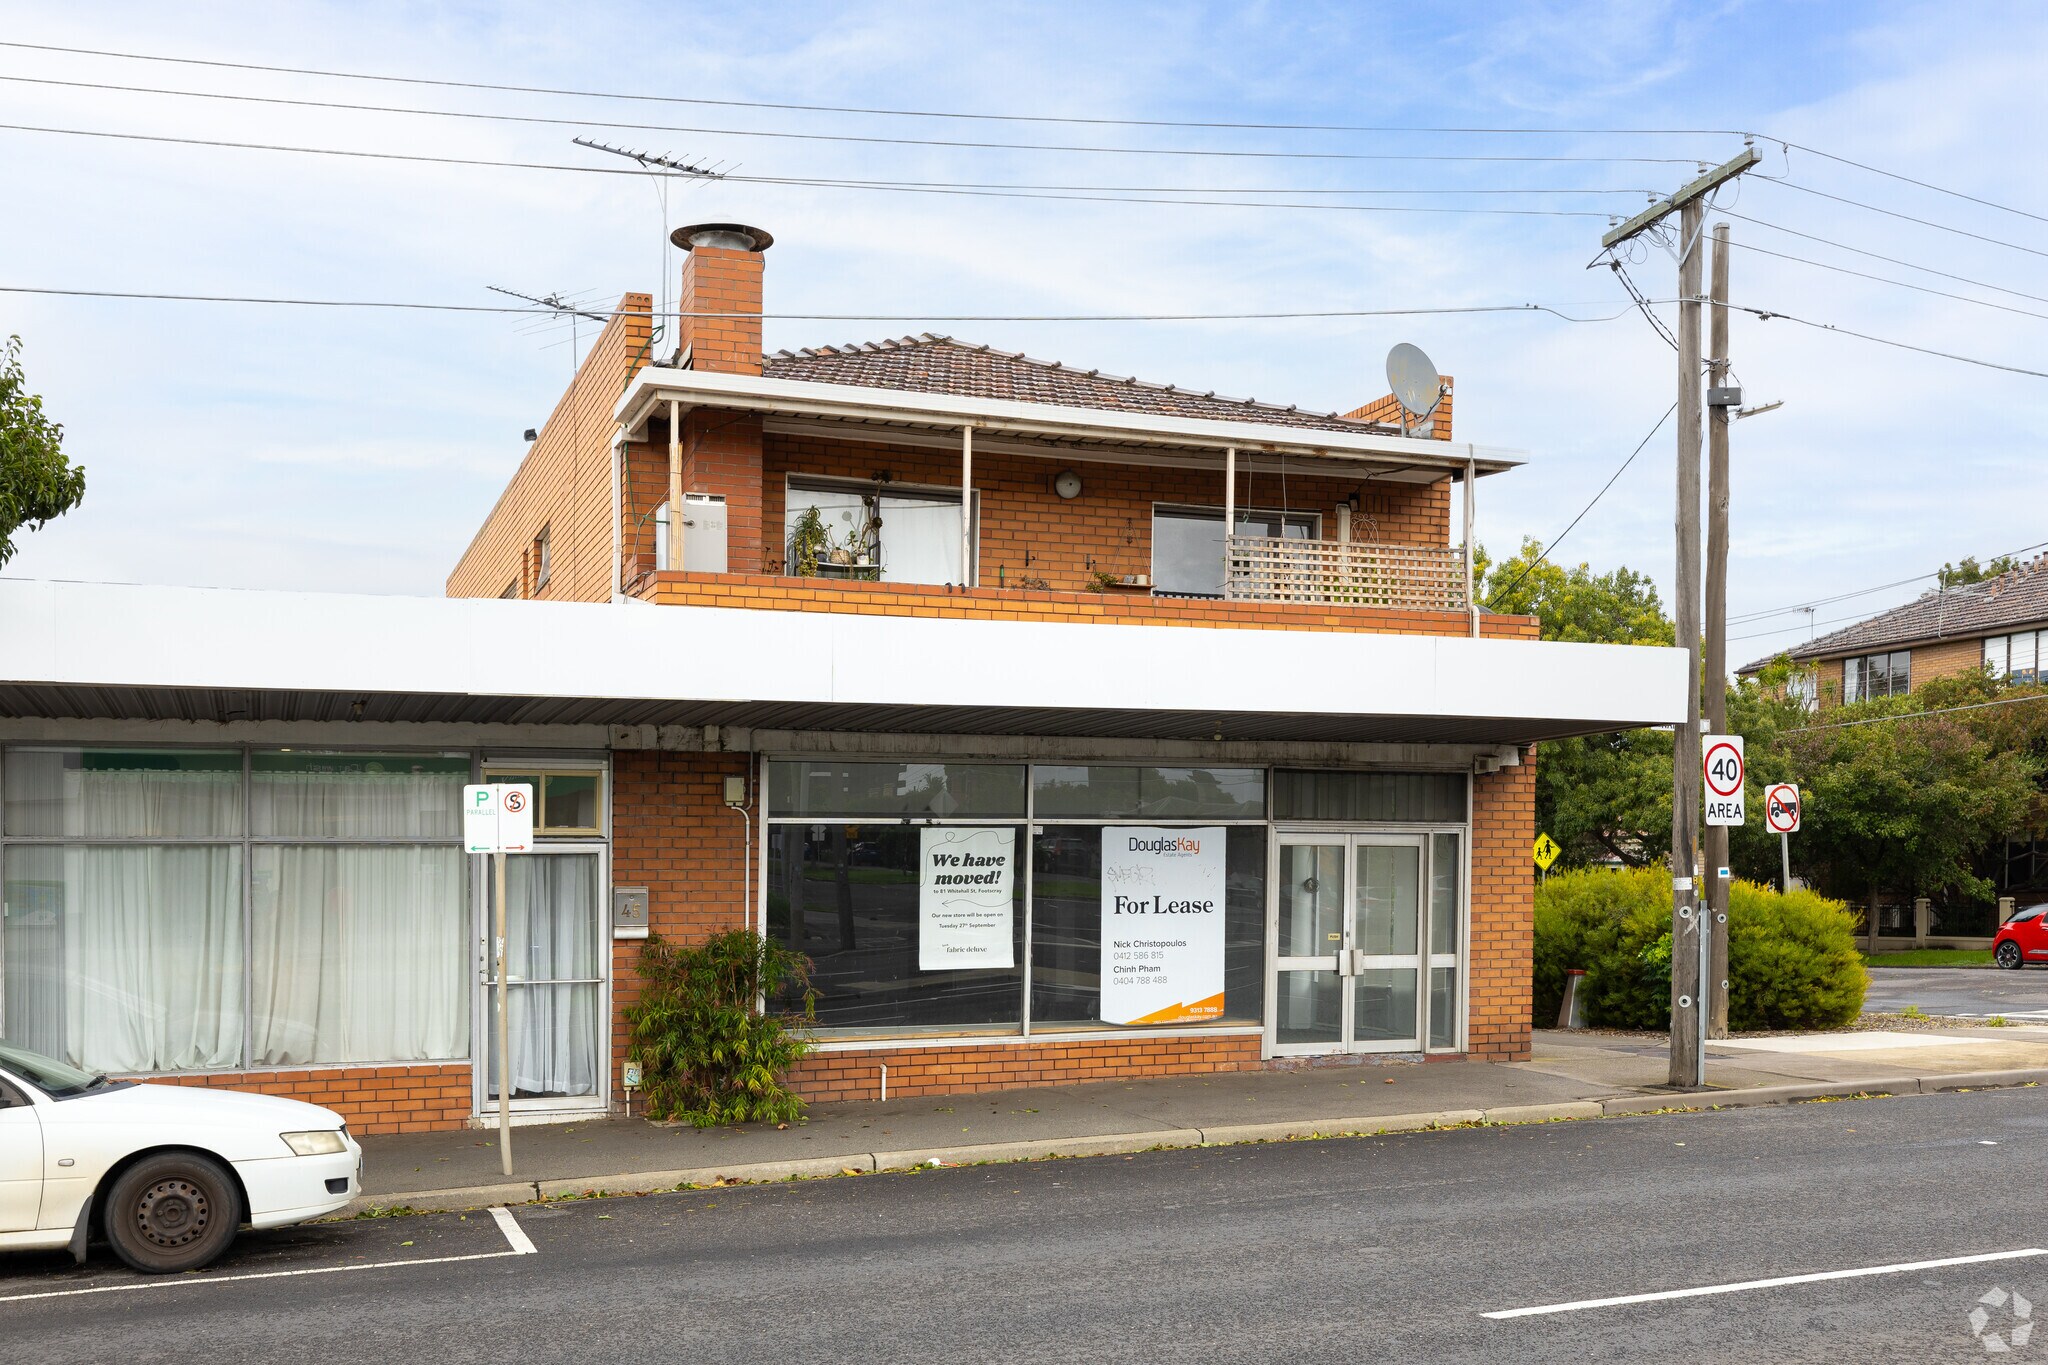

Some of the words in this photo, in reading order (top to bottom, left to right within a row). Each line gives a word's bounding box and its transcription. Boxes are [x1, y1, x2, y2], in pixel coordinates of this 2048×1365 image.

[1711, 758, 1737, 781] 40
[476, 791, 489, 807] P
[1708, 803, 1743, 818] AREA
[933, 854, 960, 867] We
[962, 853, 1006, 867] have
[934, 870, 1002, 885] moved!
[621, 903, 641, 919] 45
[1113, 895, 1150, 915] For
[1152, 895, 1214, 914] Lease
[1113, 940, 1131, 948] Nick
[1133, 940, 1187, 949] Christopoulos
[1113, 952, 1131, 960] 0412
[1133, 951, 1149, 960] 586
[1151, 951, 1164, 959] 815
[1113, 965, 1137, 974] Chinh
[1138, 965, 1161, 973] Pham
[1113, 977, 1134, 985] 0404
[1136, 976, 1151, 985] 788
[1152, 976, 1168, 984] 488
